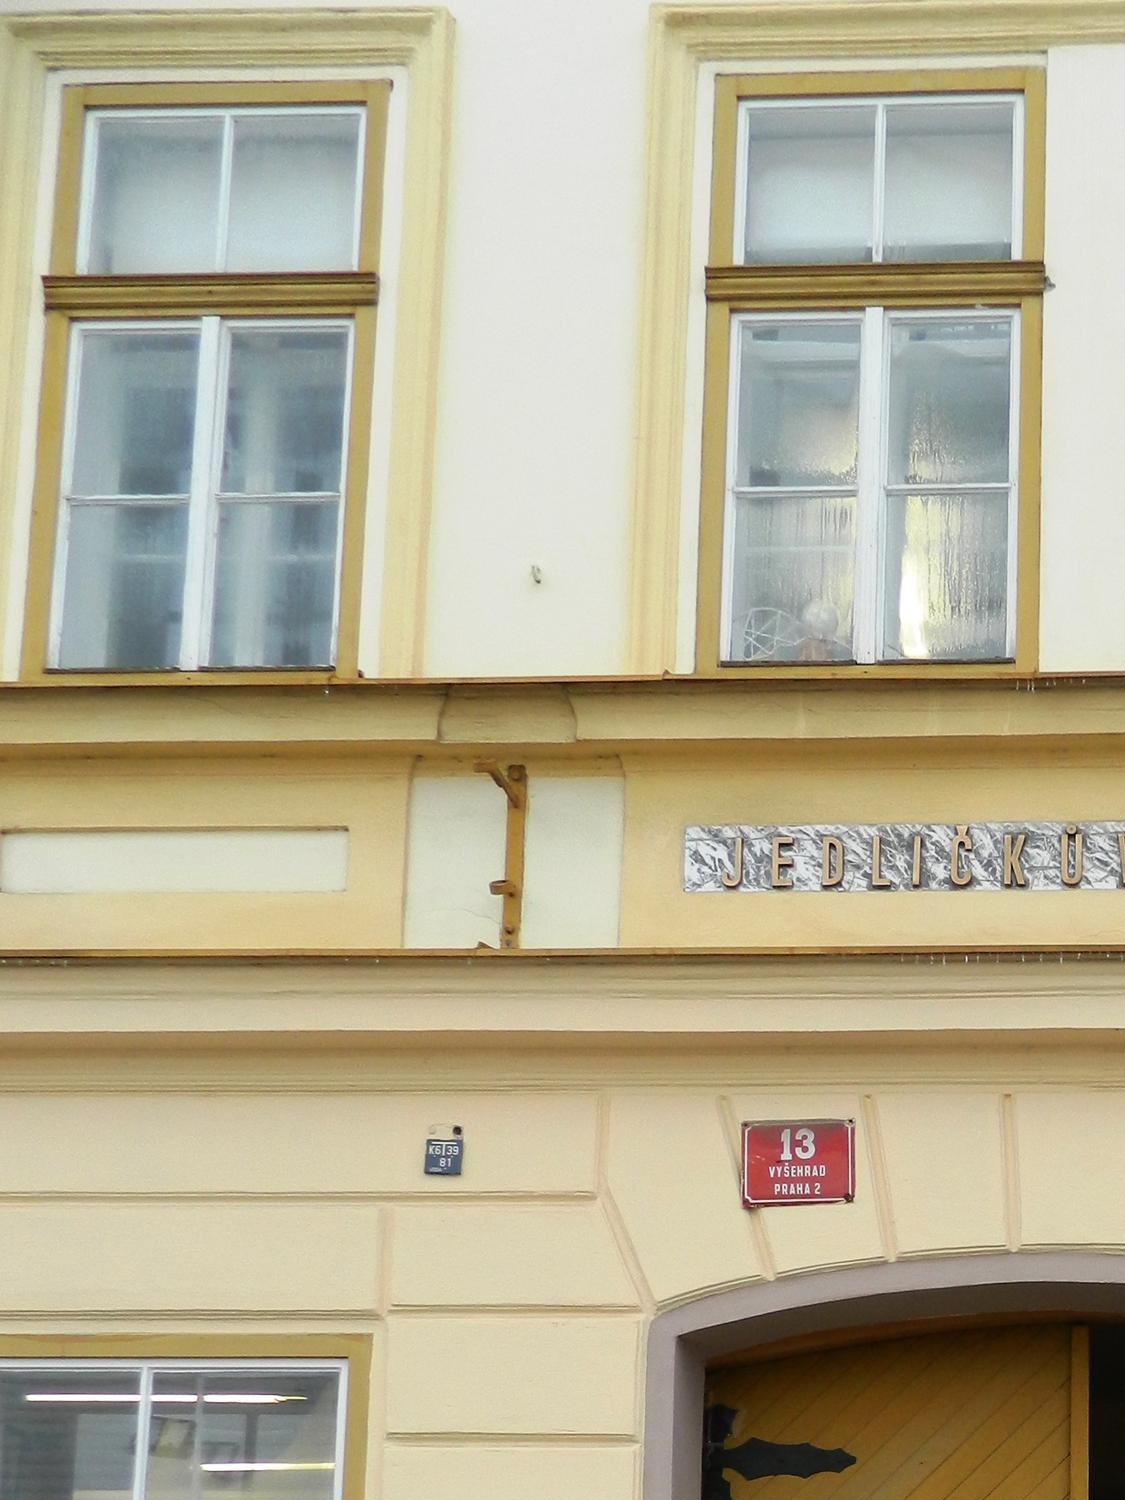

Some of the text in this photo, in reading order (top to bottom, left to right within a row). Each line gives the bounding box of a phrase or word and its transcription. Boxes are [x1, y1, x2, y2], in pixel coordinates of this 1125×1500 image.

[780, 1127, 816, 1161] 13
[768, 1162, 827, 1178] VYŠEHRAD
[774, 1182, 821, 1196] PRAHA 2
